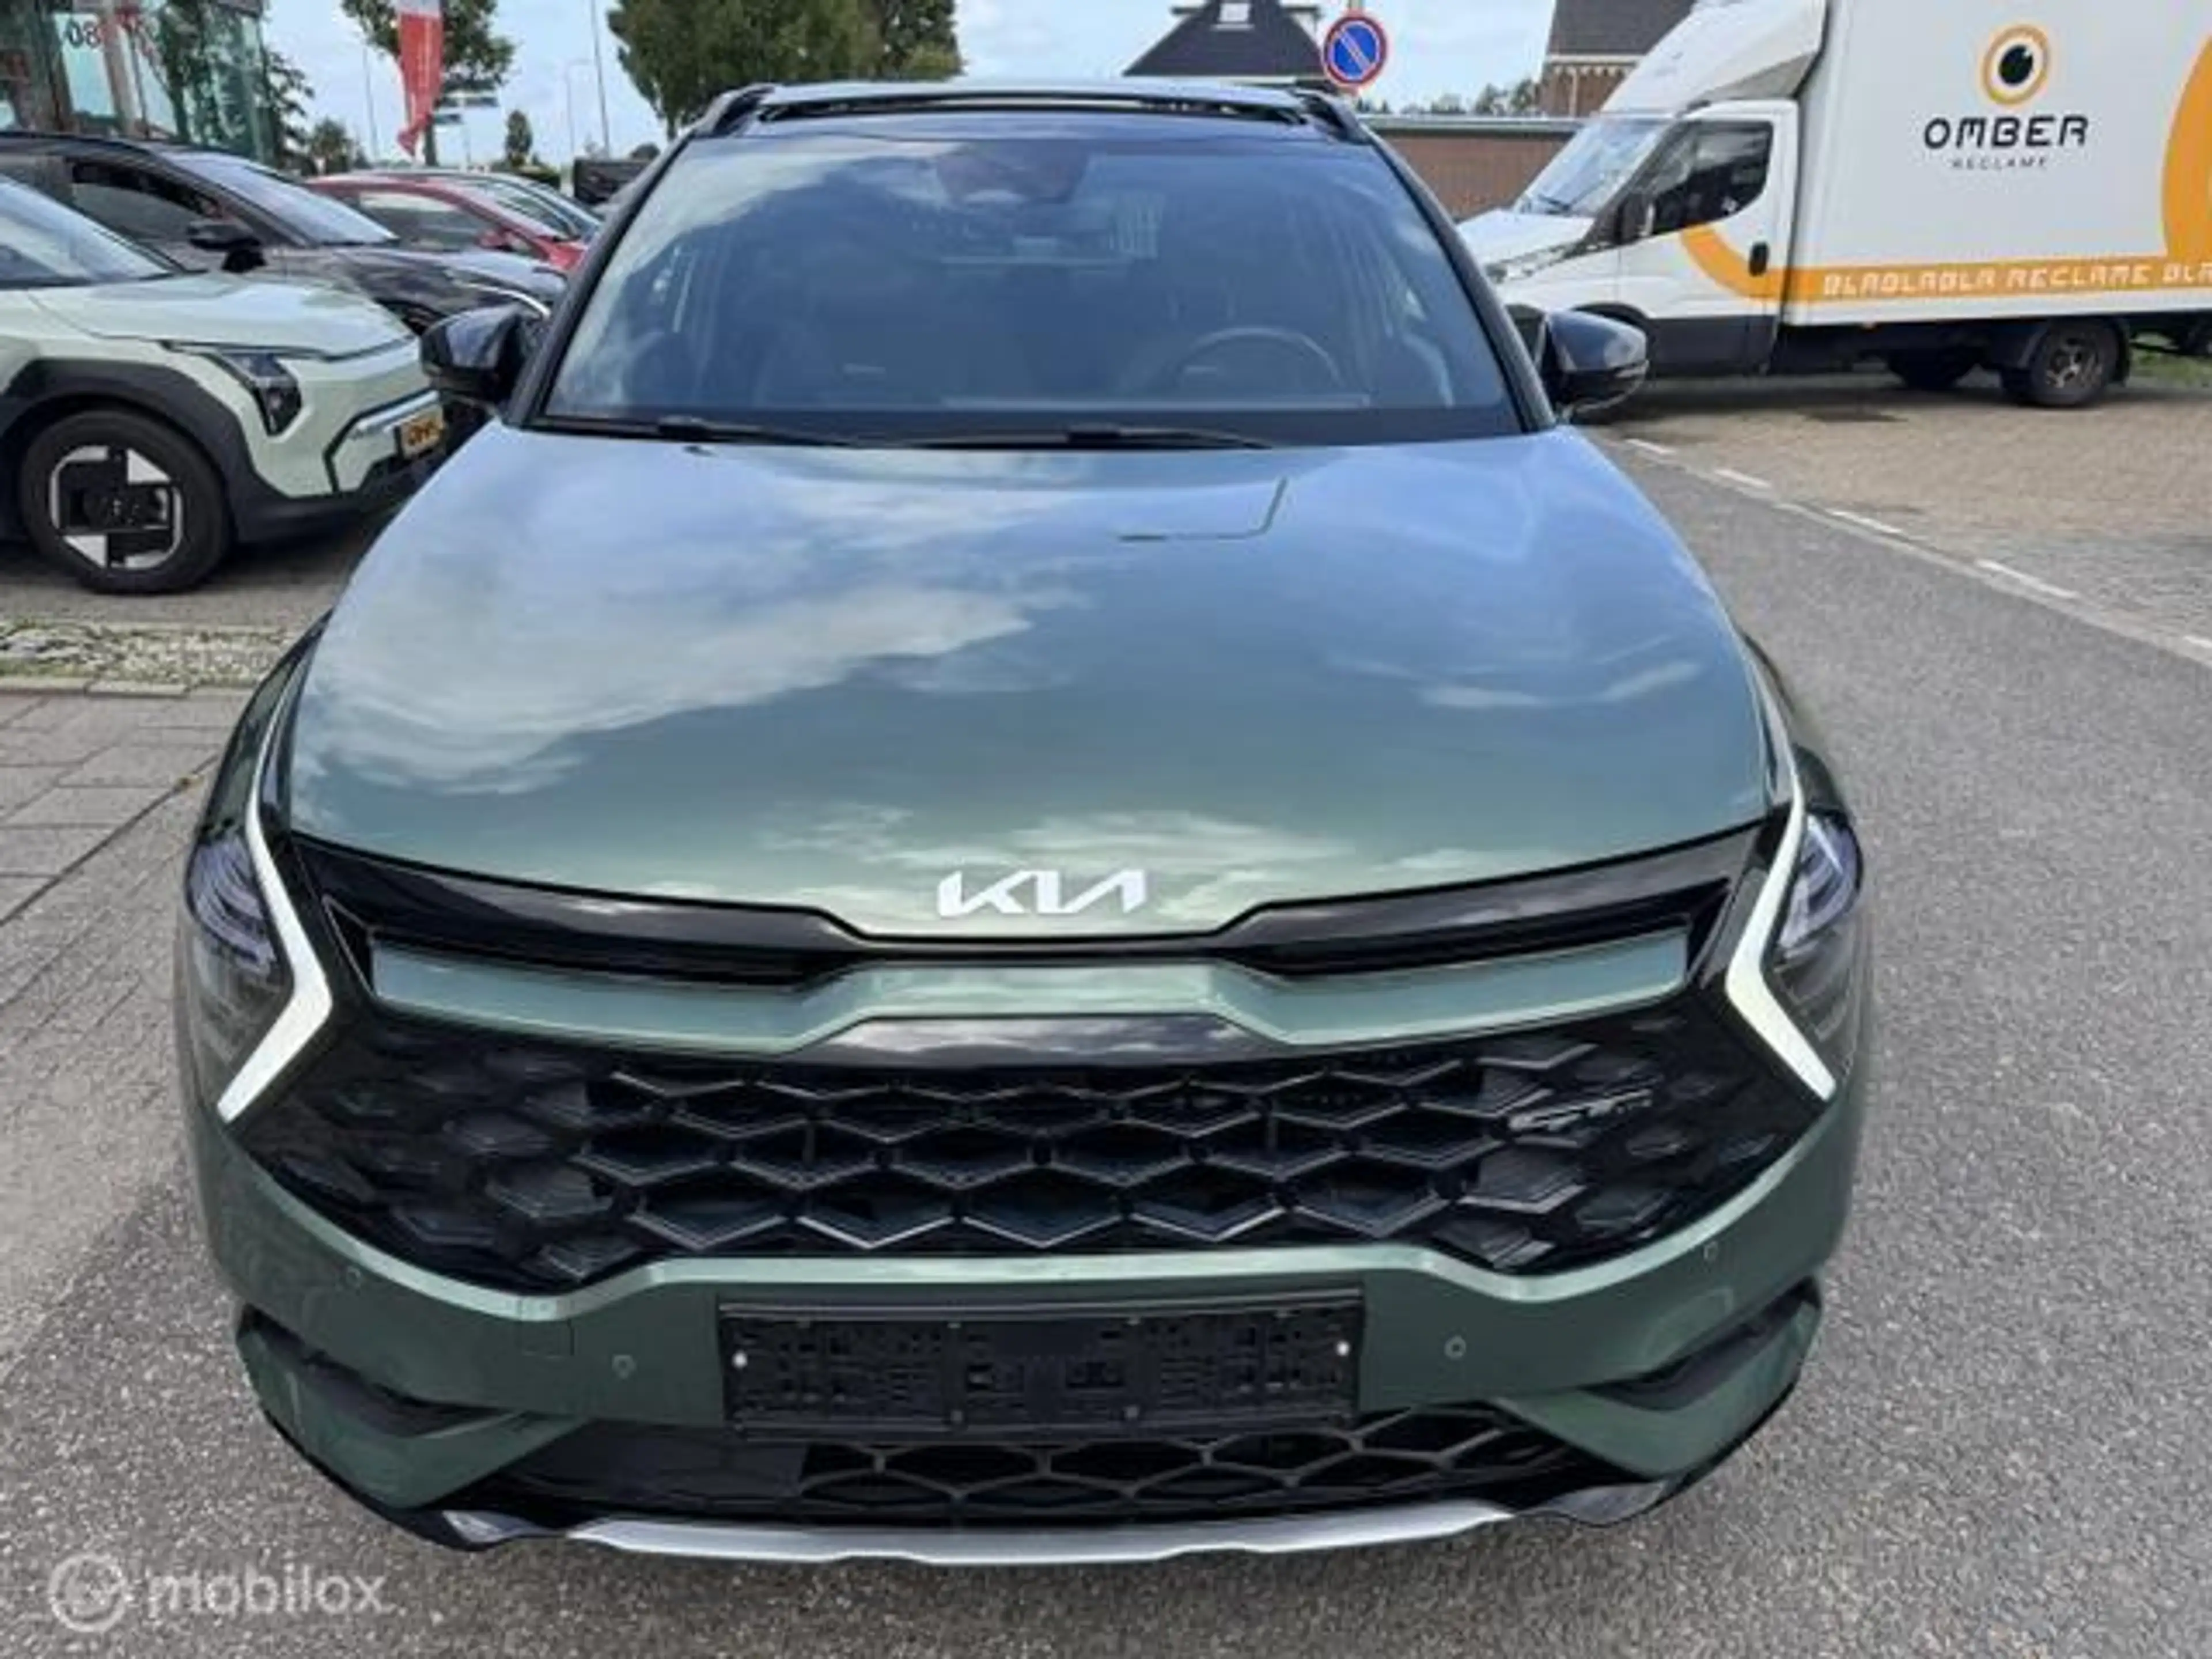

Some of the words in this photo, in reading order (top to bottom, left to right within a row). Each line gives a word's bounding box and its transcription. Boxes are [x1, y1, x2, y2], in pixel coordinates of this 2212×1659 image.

[1924, 114, 2088, 150] OMBER
[2007, 265, 2152, 288] RECLAME
[938, 869, 1147, 917] KIA
